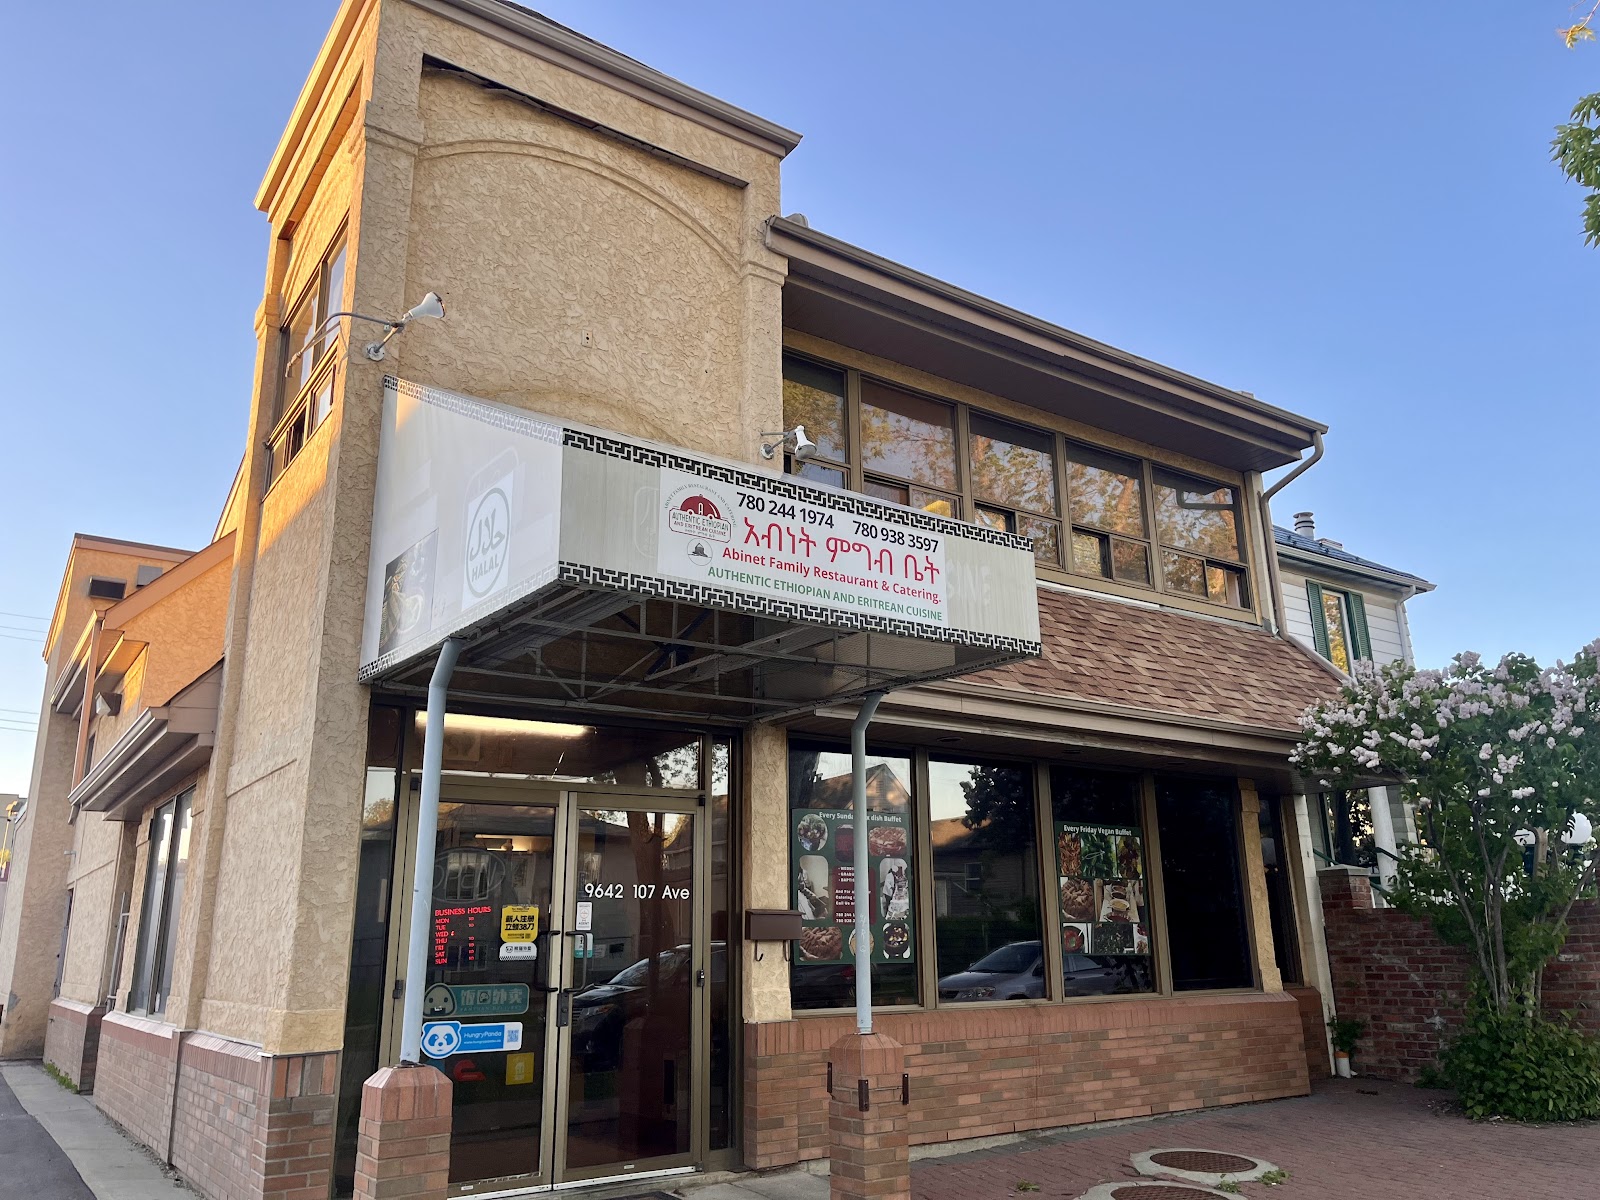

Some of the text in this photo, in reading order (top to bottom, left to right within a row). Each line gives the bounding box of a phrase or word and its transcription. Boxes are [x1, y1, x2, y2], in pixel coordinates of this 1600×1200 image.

[737, 492, 834, 528] 780 244 1974
[744, 516, 816, 557] አብነት
[904, 555, 940, 584] ቤት
[852, 520, 938, 553] 780 938 3597
[472, 554, 499, 582] HALAL
[722, 547, 942, 604] Abinet Family Restaurant & Catering.
[708, 566, 942, 621] AUTHENTIC ETHIOPIAN AND ERITREAN CUISINE
[819, 812, 836, 820] Every
[1063, 825, 1079, 833] Every
[1080, 826, 1097, 834] Friday
[1098, 827, 1114, 836] Vegan
[585, 883, 690, 899] 9642 107 Ave
[435, 908, 465, 916] BUSINESS
